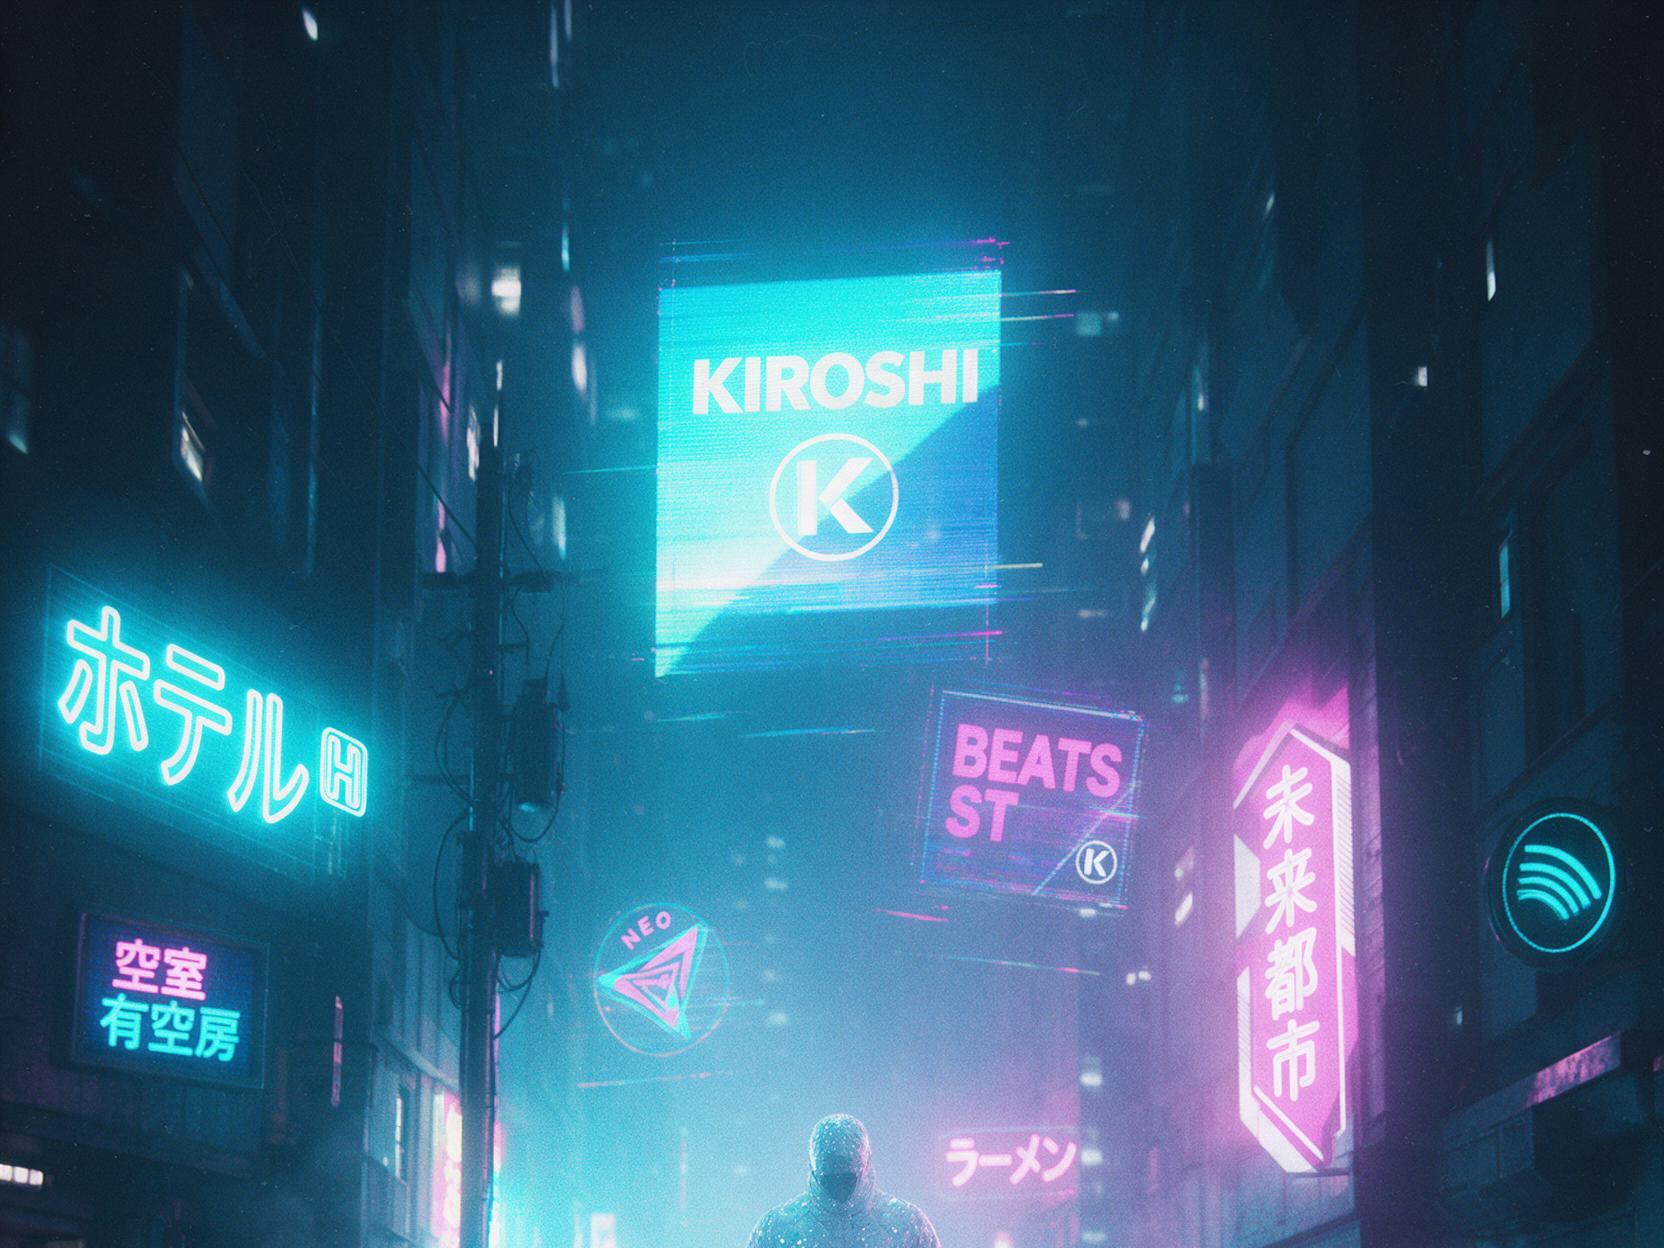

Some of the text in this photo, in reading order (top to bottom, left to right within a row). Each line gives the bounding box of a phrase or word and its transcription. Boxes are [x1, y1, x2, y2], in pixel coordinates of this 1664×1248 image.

[692, 349, 979, 416] KIROSHI
[57, 605, 310, 824] ホテル
[952, 723, 1123, 799] BEATS
[945, 784, 1020, 842] ST
[620, 911, 672, 950] NEO
[1263, 764, 1321, 1101] 未来都市
[112, 938, 208, 1001] 空室
[100, 993, 241, 1062] 有空房
[946, 1134, 1077, 1187] ラーメン
